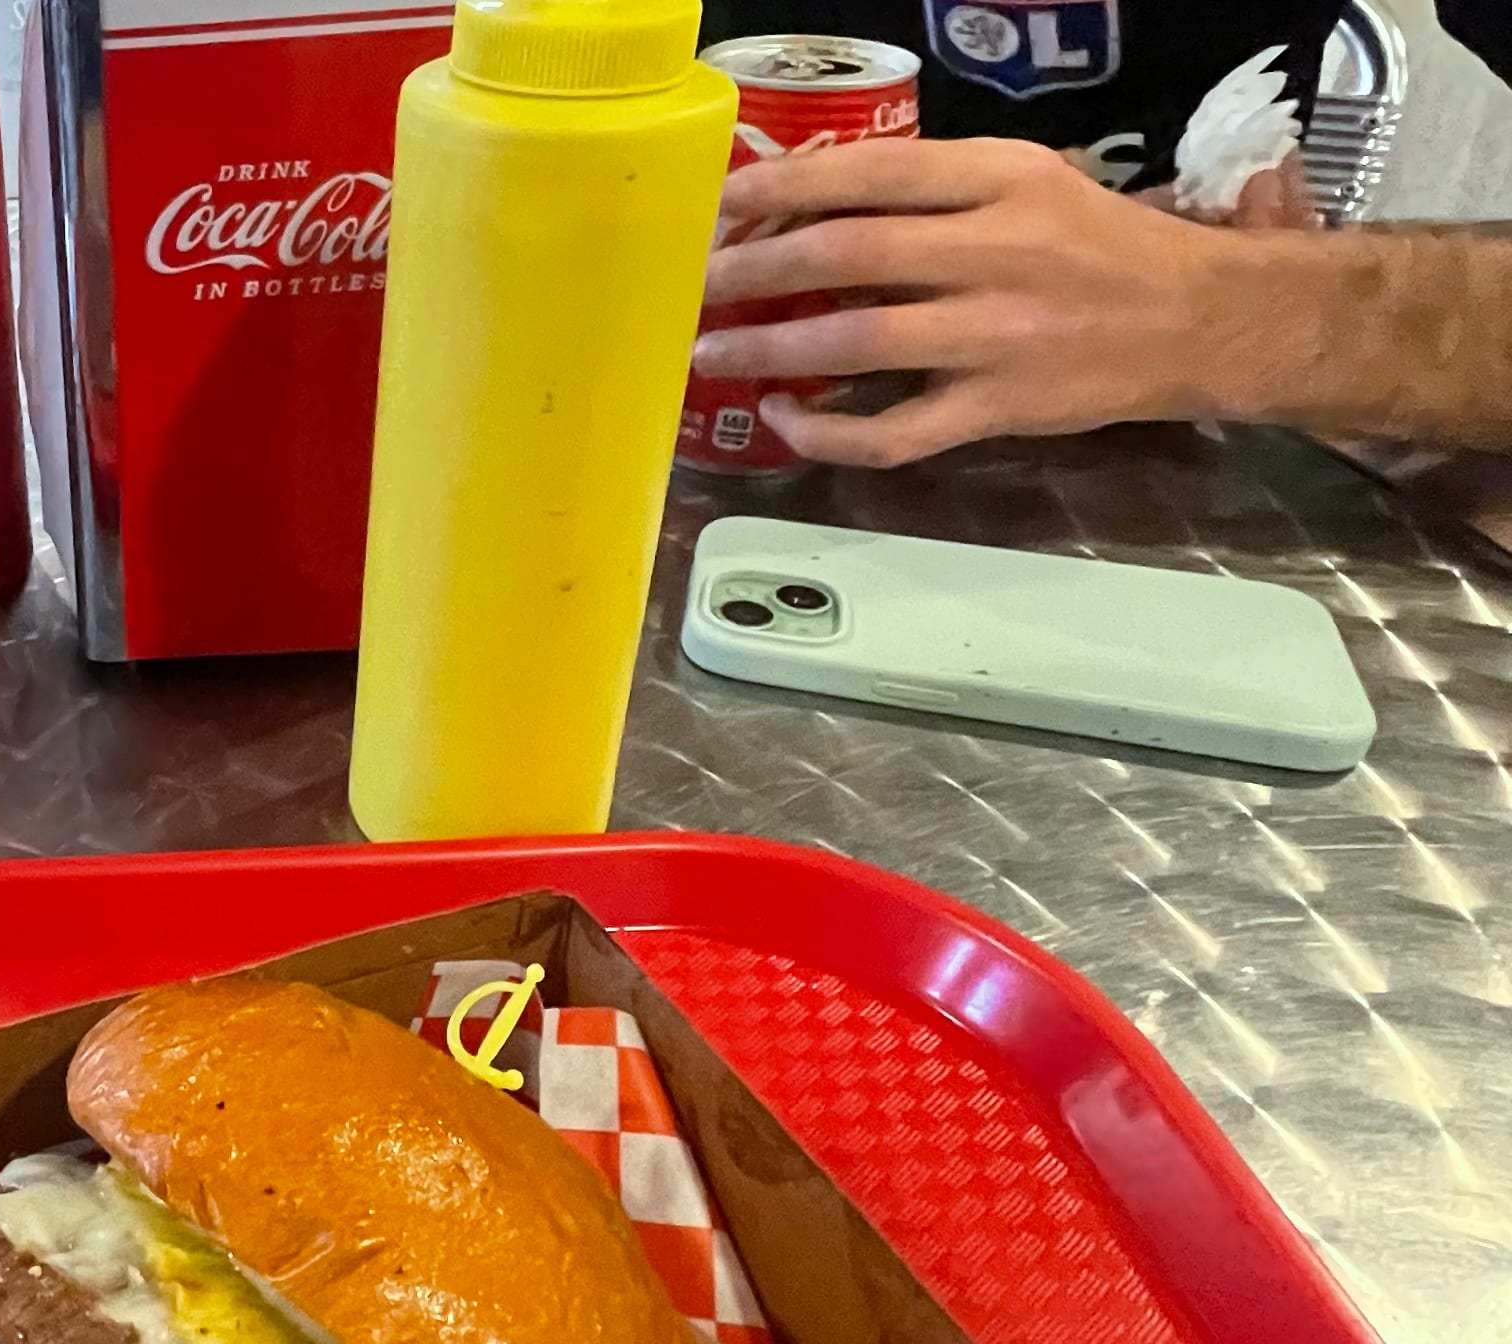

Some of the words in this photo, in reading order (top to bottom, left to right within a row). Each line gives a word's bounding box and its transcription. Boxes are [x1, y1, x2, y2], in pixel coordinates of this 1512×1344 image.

[217, 159, 312, 183] DRINK
[193, 281, 228, 301] IN
[241, 272, 386, 299] BOTTLES
